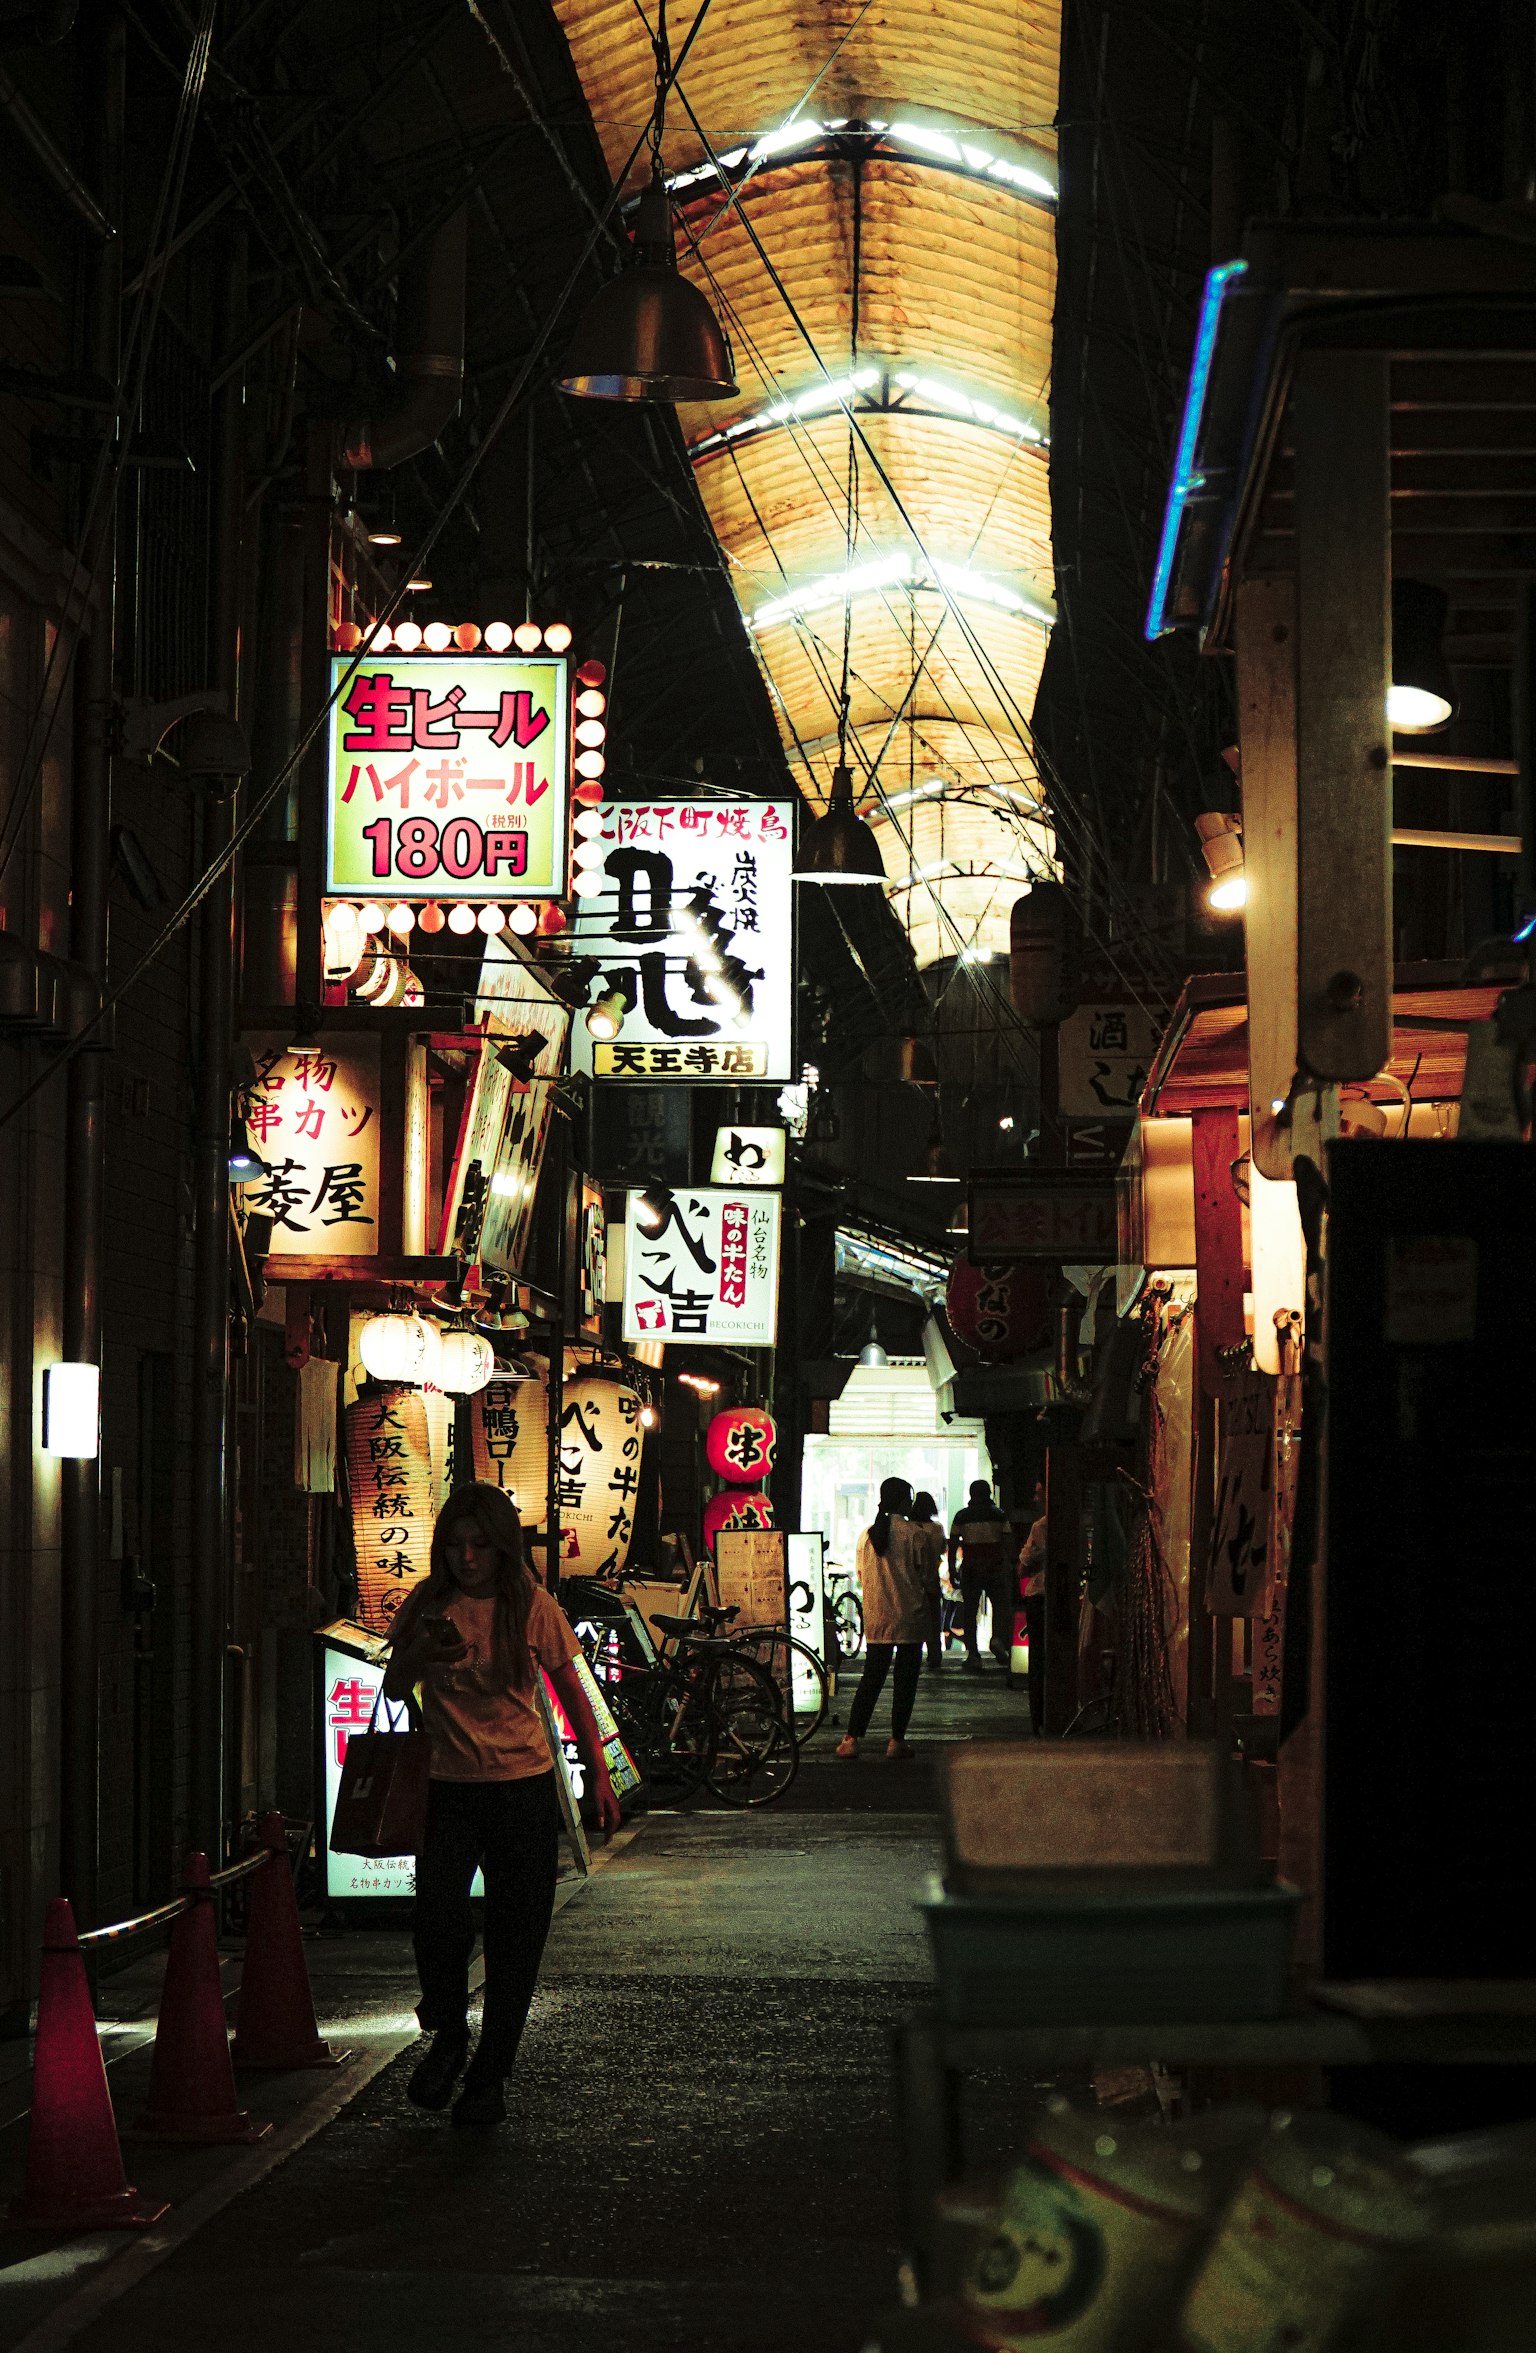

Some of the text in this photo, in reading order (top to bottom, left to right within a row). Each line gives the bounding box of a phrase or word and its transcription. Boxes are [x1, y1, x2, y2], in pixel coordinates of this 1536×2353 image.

[342, 674, 550, 751] 生ビール
[341, 757, 549, 808] ハイボール
[363, 817, 527, 879] 180円
[256, 1049, 337, 1092] 名物
[611, 1046, 754, 1073] 天王寺店
[247, 1099, 373, 1143] 串カツ
[243, 1158, 374, 1232] 菱屋
[636, 1199, 717, 1333] べこ吉
[722, 1209, 748, 1302] 味の牛たん
[749, 1209, 770, 1279] 仙台名物
[709, 1320, 765, 1331] BECOKICHI
[726, 1423, 764, 1470] 串
[369, 1406, 427, 1578] 大阪伝統の味
